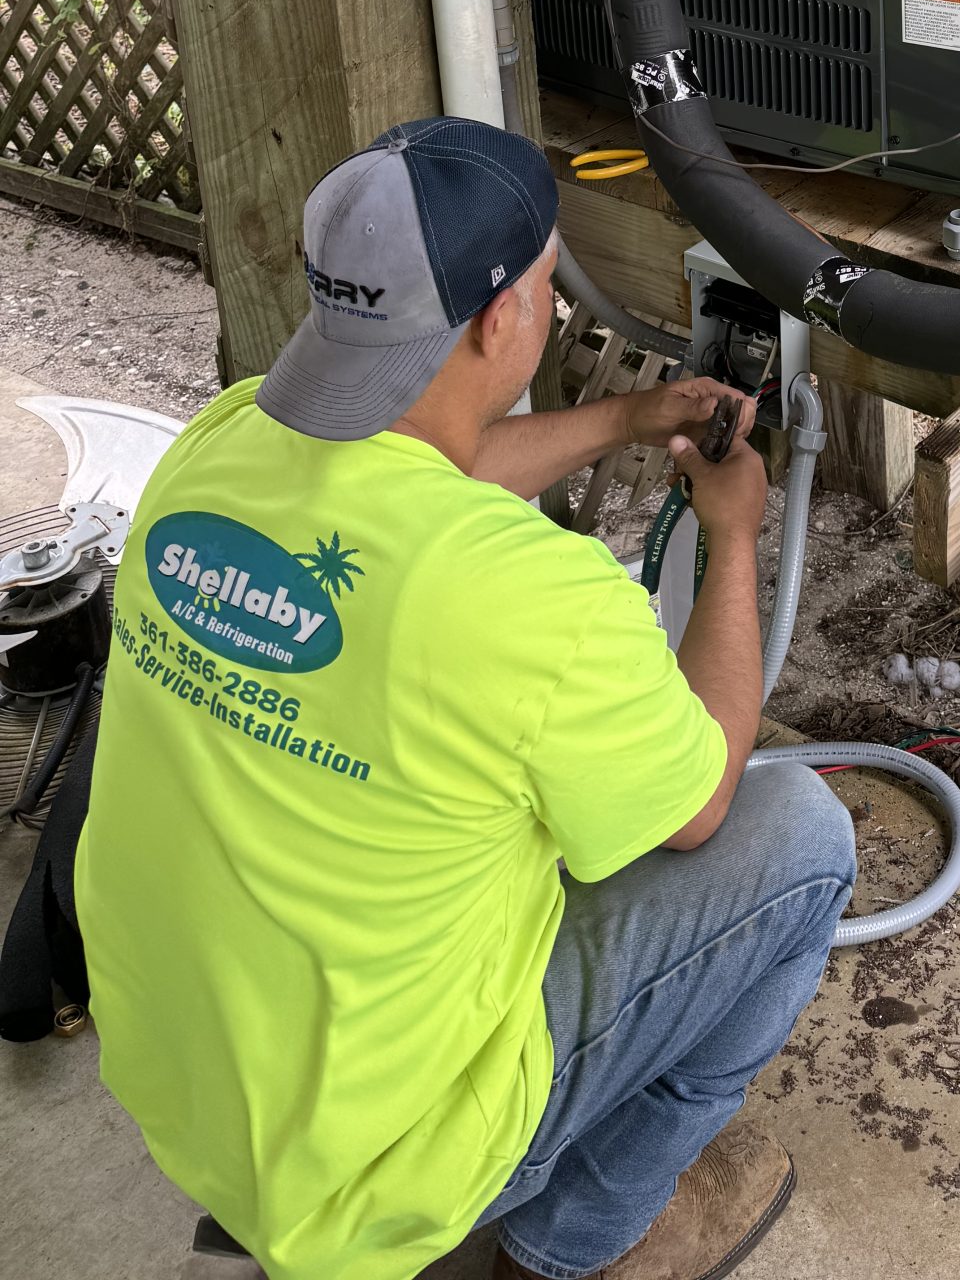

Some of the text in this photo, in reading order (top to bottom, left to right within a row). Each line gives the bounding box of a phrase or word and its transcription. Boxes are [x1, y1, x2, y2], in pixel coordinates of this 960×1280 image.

[332, 303, 389, 321] SYSTEMS
[651, 504, 677, 562] KLEIN TOOLS
[157, 543, 328, 645] Shellaby
[171, 599, 294, 665] A/C & Refrigeration
[140, 611, 302, 723] 361-386-2886
